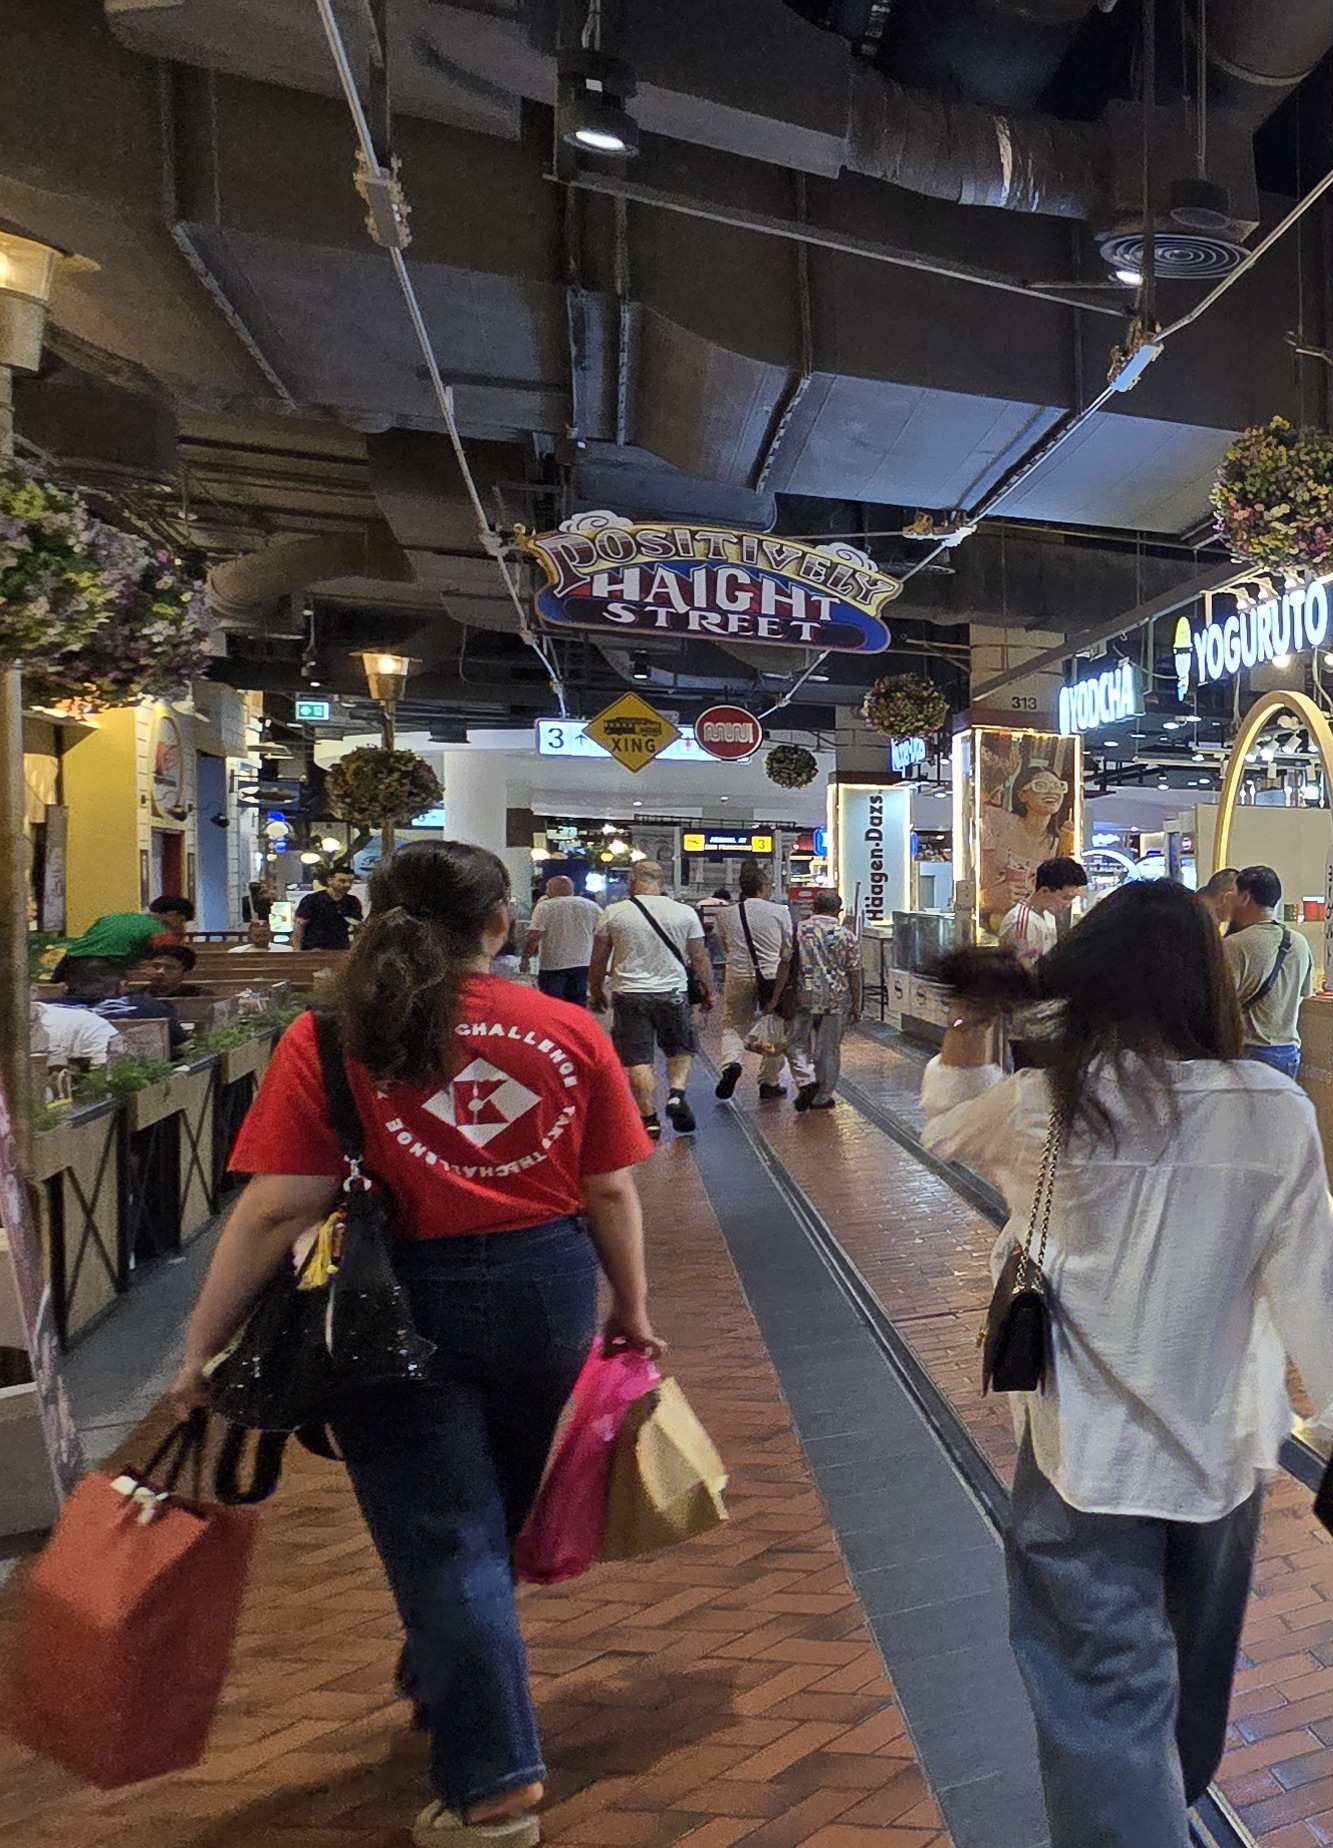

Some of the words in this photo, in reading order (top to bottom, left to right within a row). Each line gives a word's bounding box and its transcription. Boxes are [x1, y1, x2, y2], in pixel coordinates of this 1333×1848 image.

[535, 528, 900, 605] POSITIVELY
[591, 566, 841, 622] HAIGHT
[602, 602, 822, 641] STREET
[1193, 580, 1329, 684] YOGURUTO
[1011, 697, 1037, 710] 313
[547, 727, 565, 749] 3
[611, 738, 656, 753] XING
[757, 839, 766, 850] 3
